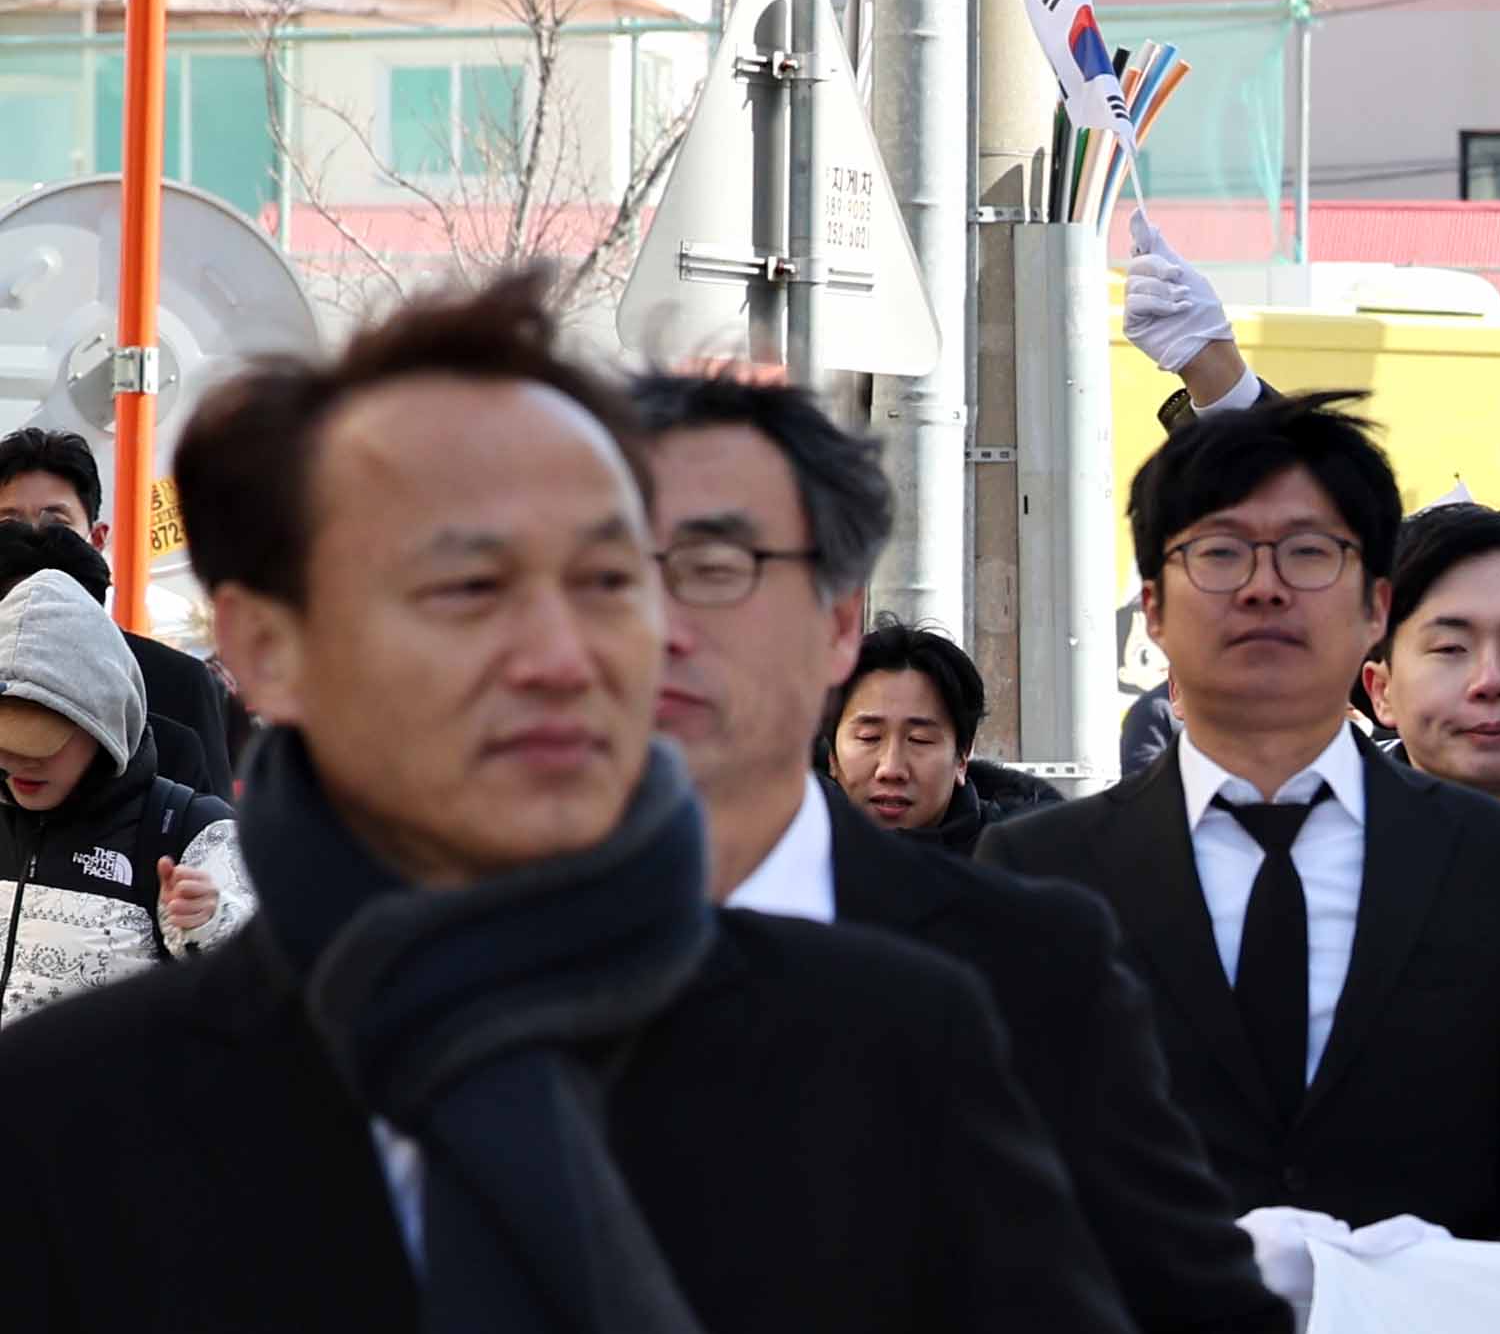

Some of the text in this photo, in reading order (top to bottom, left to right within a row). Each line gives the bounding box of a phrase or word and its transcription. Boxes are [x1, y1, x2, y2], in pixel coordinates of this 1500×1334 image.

[72, 851, 115, 871] NORTH
[93, 846, 118, 861] THE
[82, 864, 114, 881] FACE
